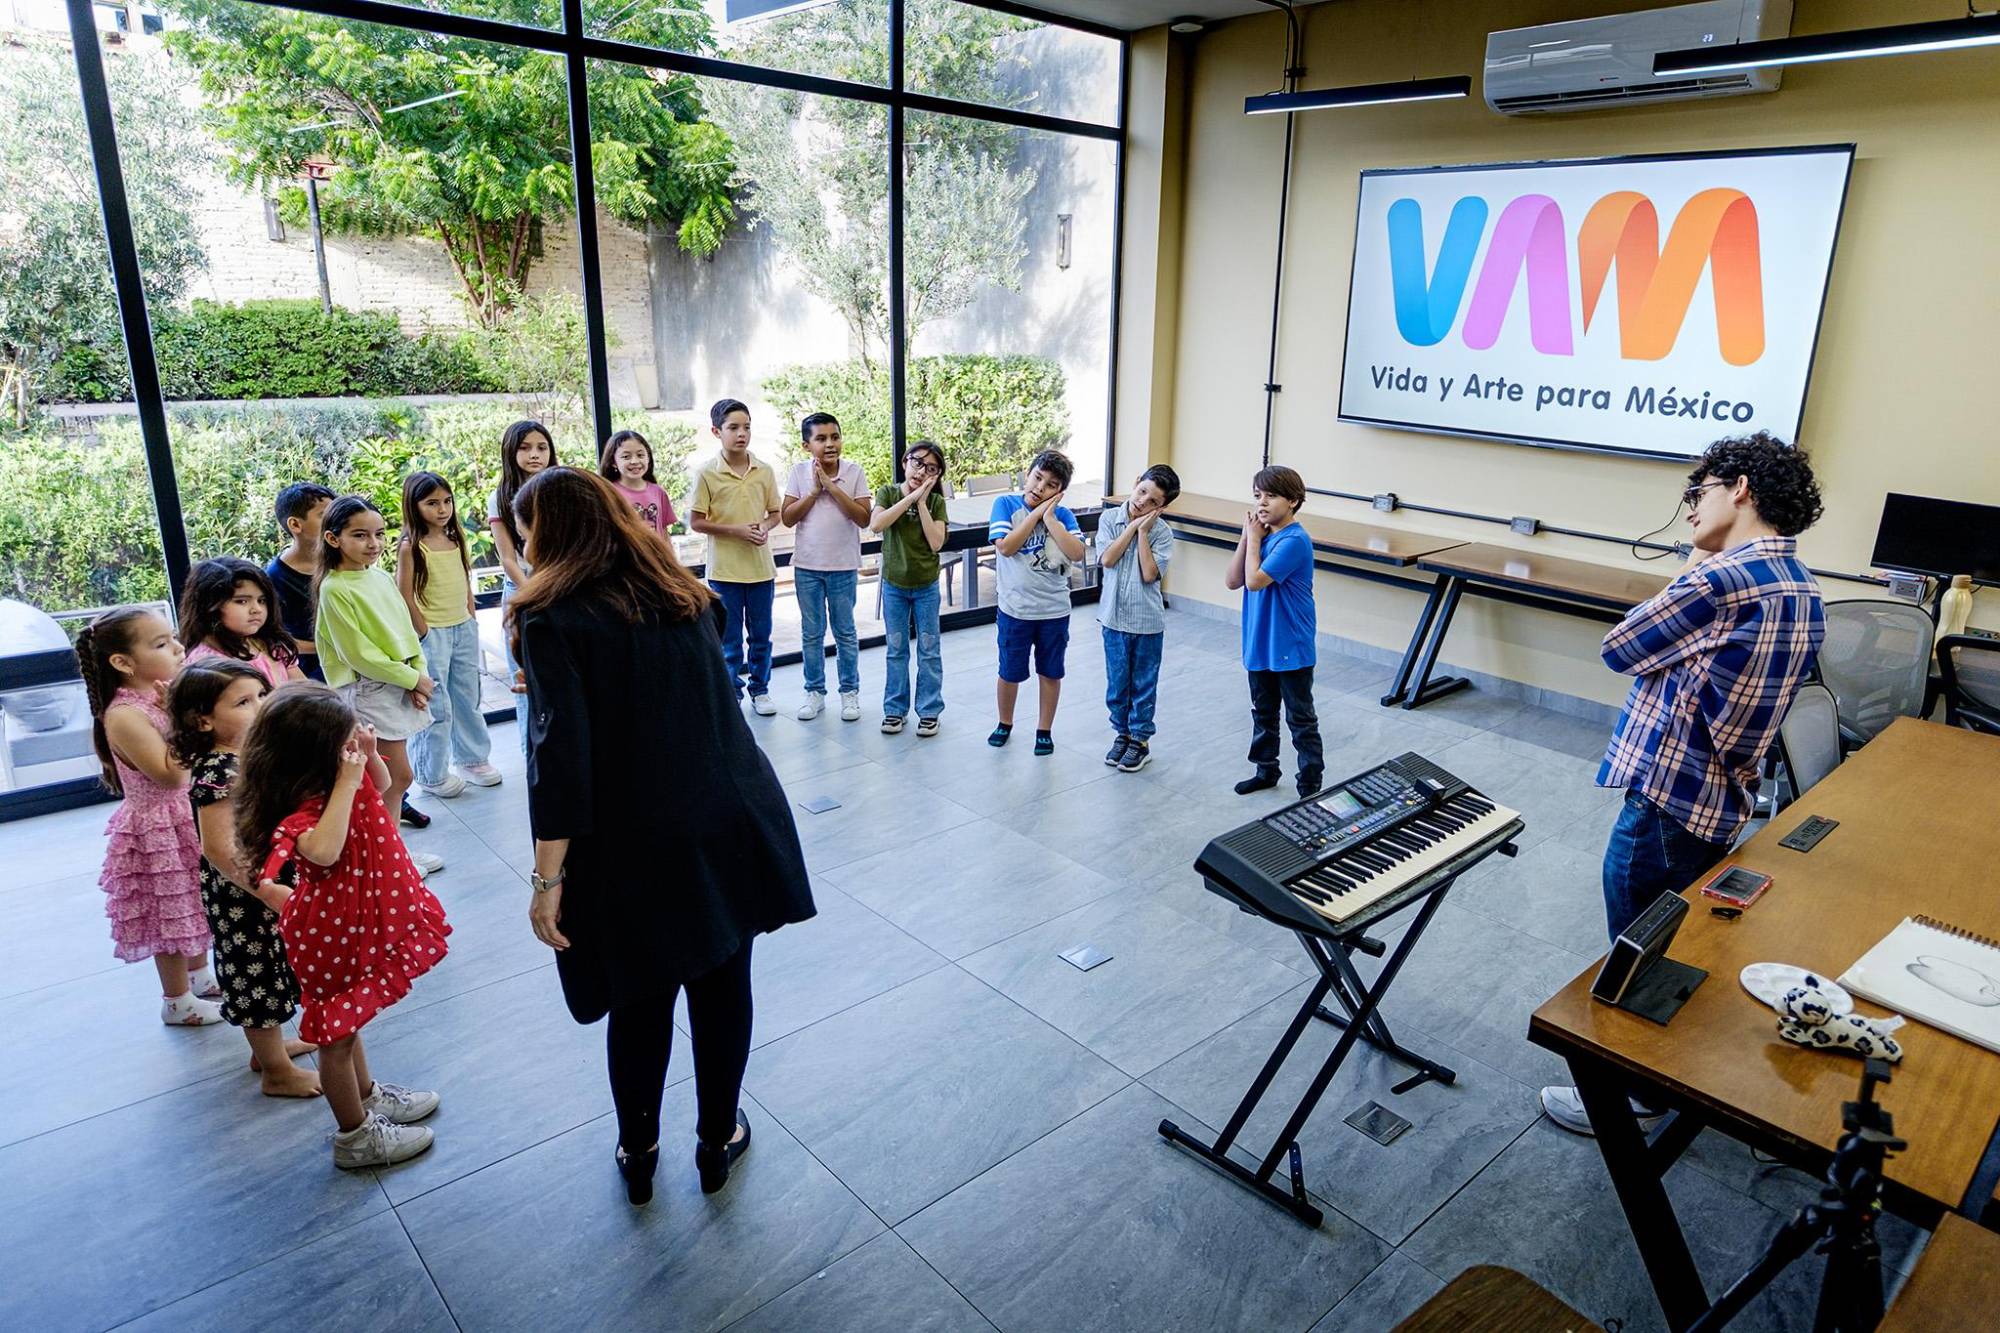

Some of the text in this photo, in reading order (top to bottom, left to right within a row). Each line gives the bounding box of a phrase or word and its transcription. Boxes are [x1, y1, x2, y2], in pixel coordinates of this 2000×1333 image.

[1387, 187, 1765, 366] VAM
[1371, 366, 1754, 423] Vida y Arte para México
